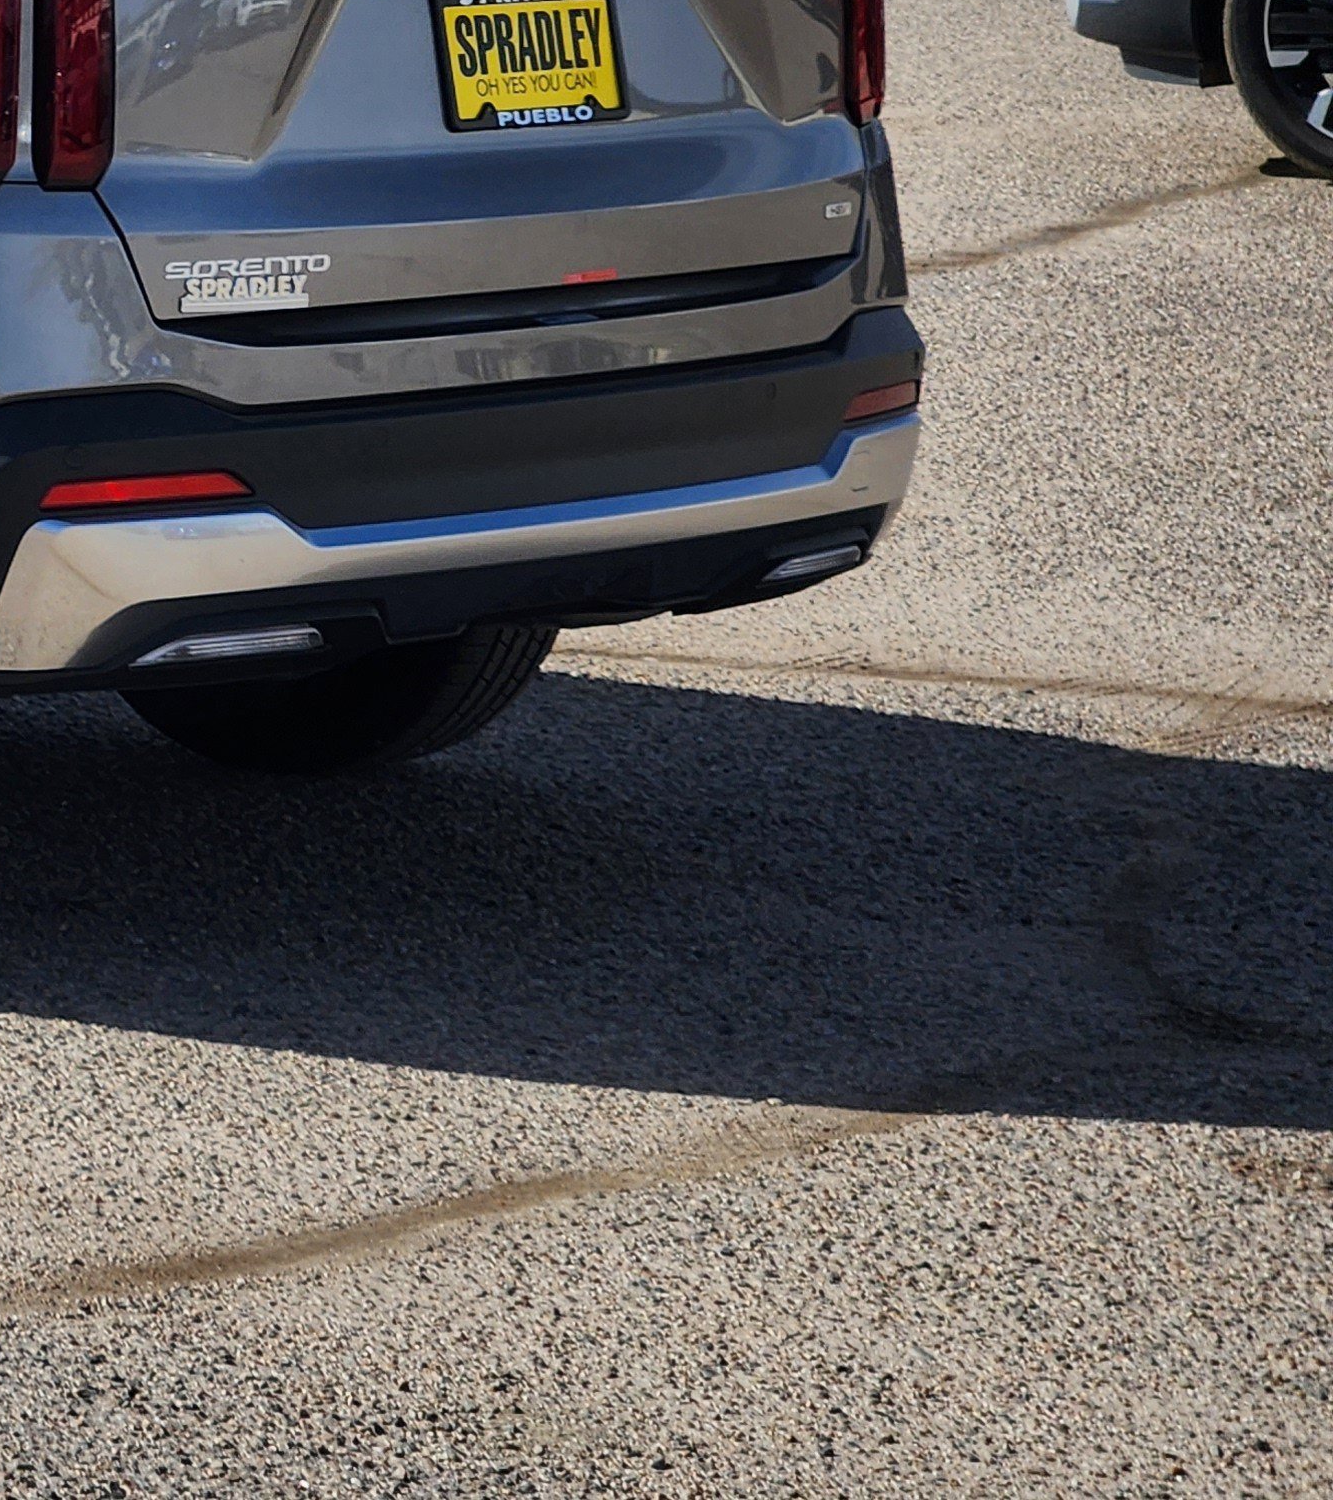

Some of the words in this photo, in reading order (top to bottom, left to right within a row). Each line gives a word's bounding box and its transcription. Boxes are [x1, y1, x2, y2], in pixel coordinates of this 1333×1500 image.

[454, 7, 602, 78] SPRADLEY
[476, 77, 500, 97] OH
[503, 75, 527, 95] YES
[532, 73, 560, 93] YOU
[564, 71, 598, 91] CAN!
[497, 105, 593, 127] PUEBLO
[164, 254, 332, 280] SORENTO
[185, 274, 308, 301] SPRADLEY
